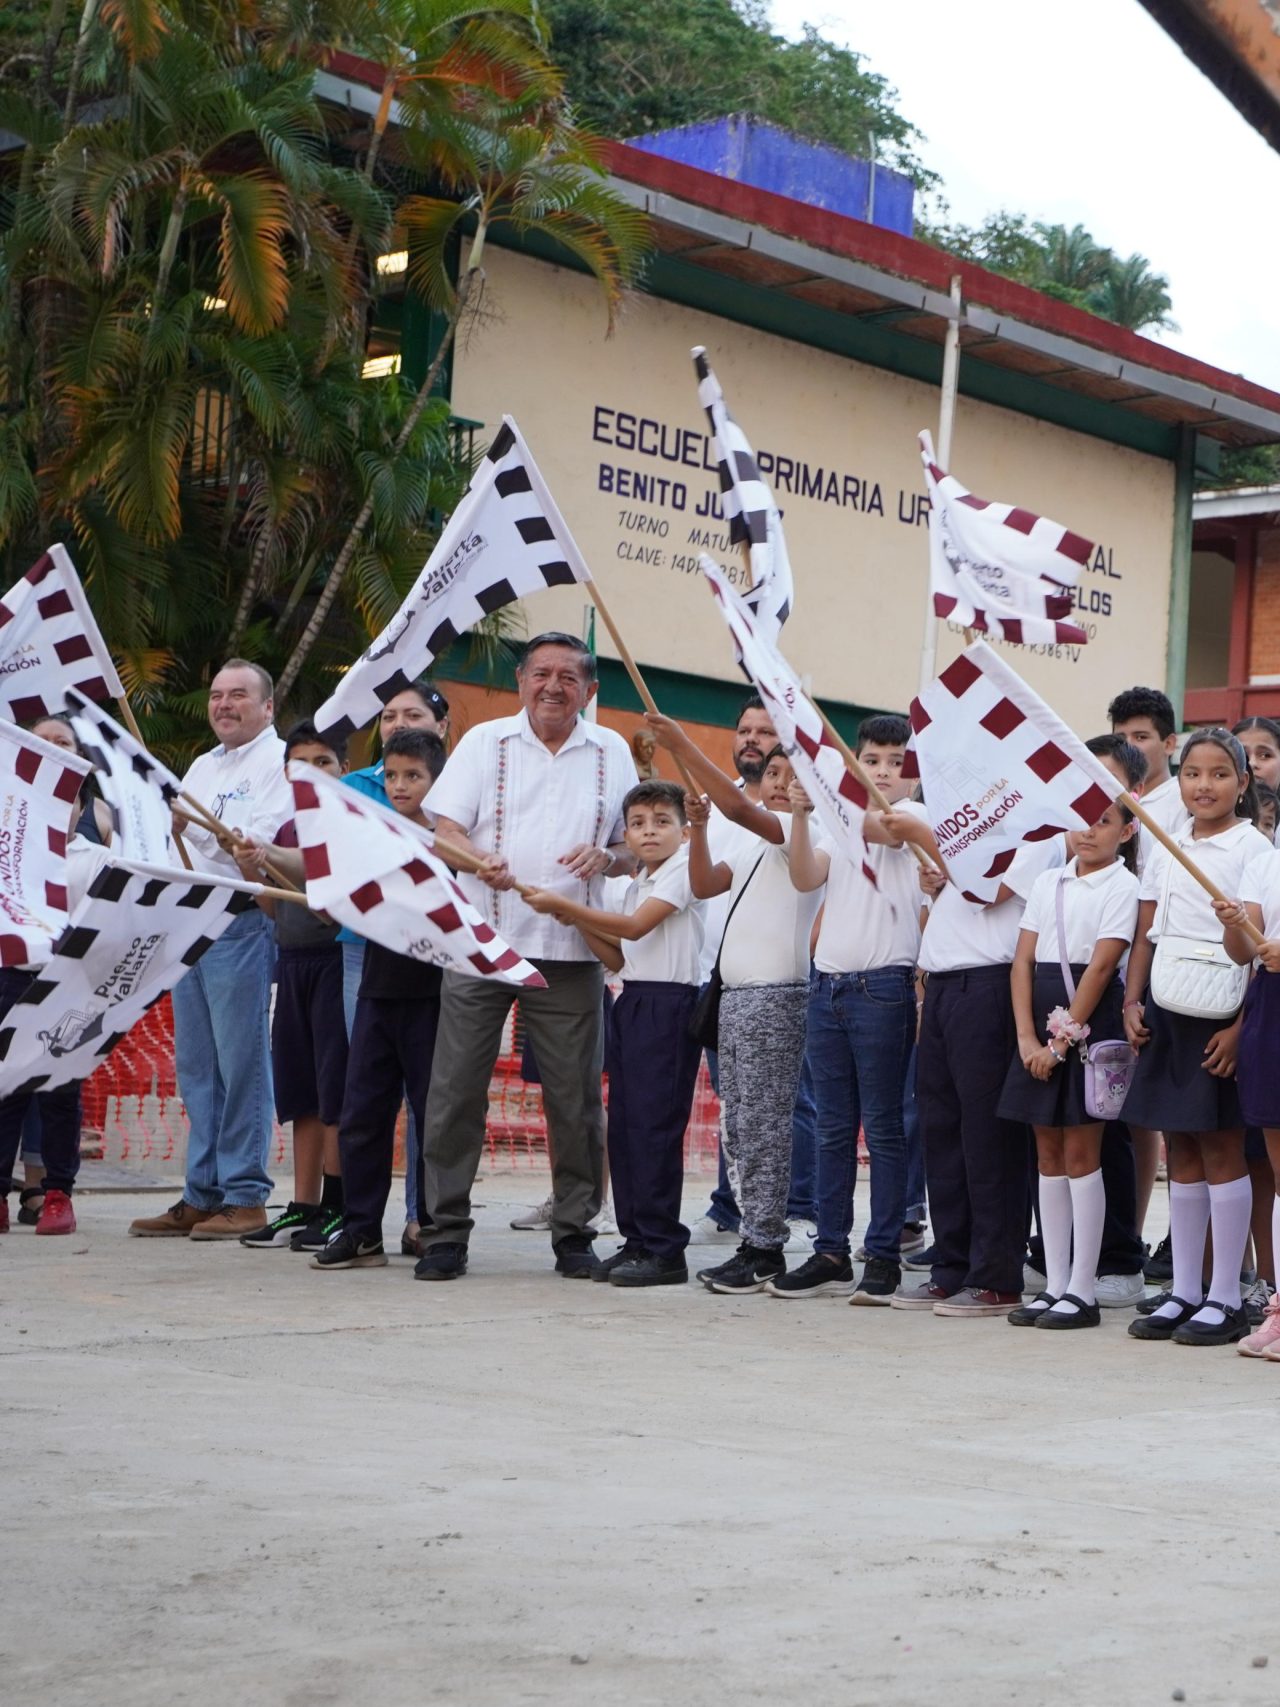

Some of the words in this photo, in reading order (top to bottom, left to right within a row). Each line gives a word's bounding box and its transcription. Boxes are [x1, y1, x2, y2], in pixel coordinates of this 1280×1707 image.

[593, 406, 721, 474] ESCUEL
[757, 450, 884, 517] PRIMARIA
[598, 463, 687, 511] BENITO
[619, 511, 669, 538] TURNO
[616, 541, 667, 567] CLAVE:
[976, 787, 997, 810] POR
[994, 777, 1009, 792] LA
[942, 789, 1023, 861] TRANSFORMACIÓN
[94, 936, 142, 999] Puerto
[108, 933, 161, 1008] Vallarta
